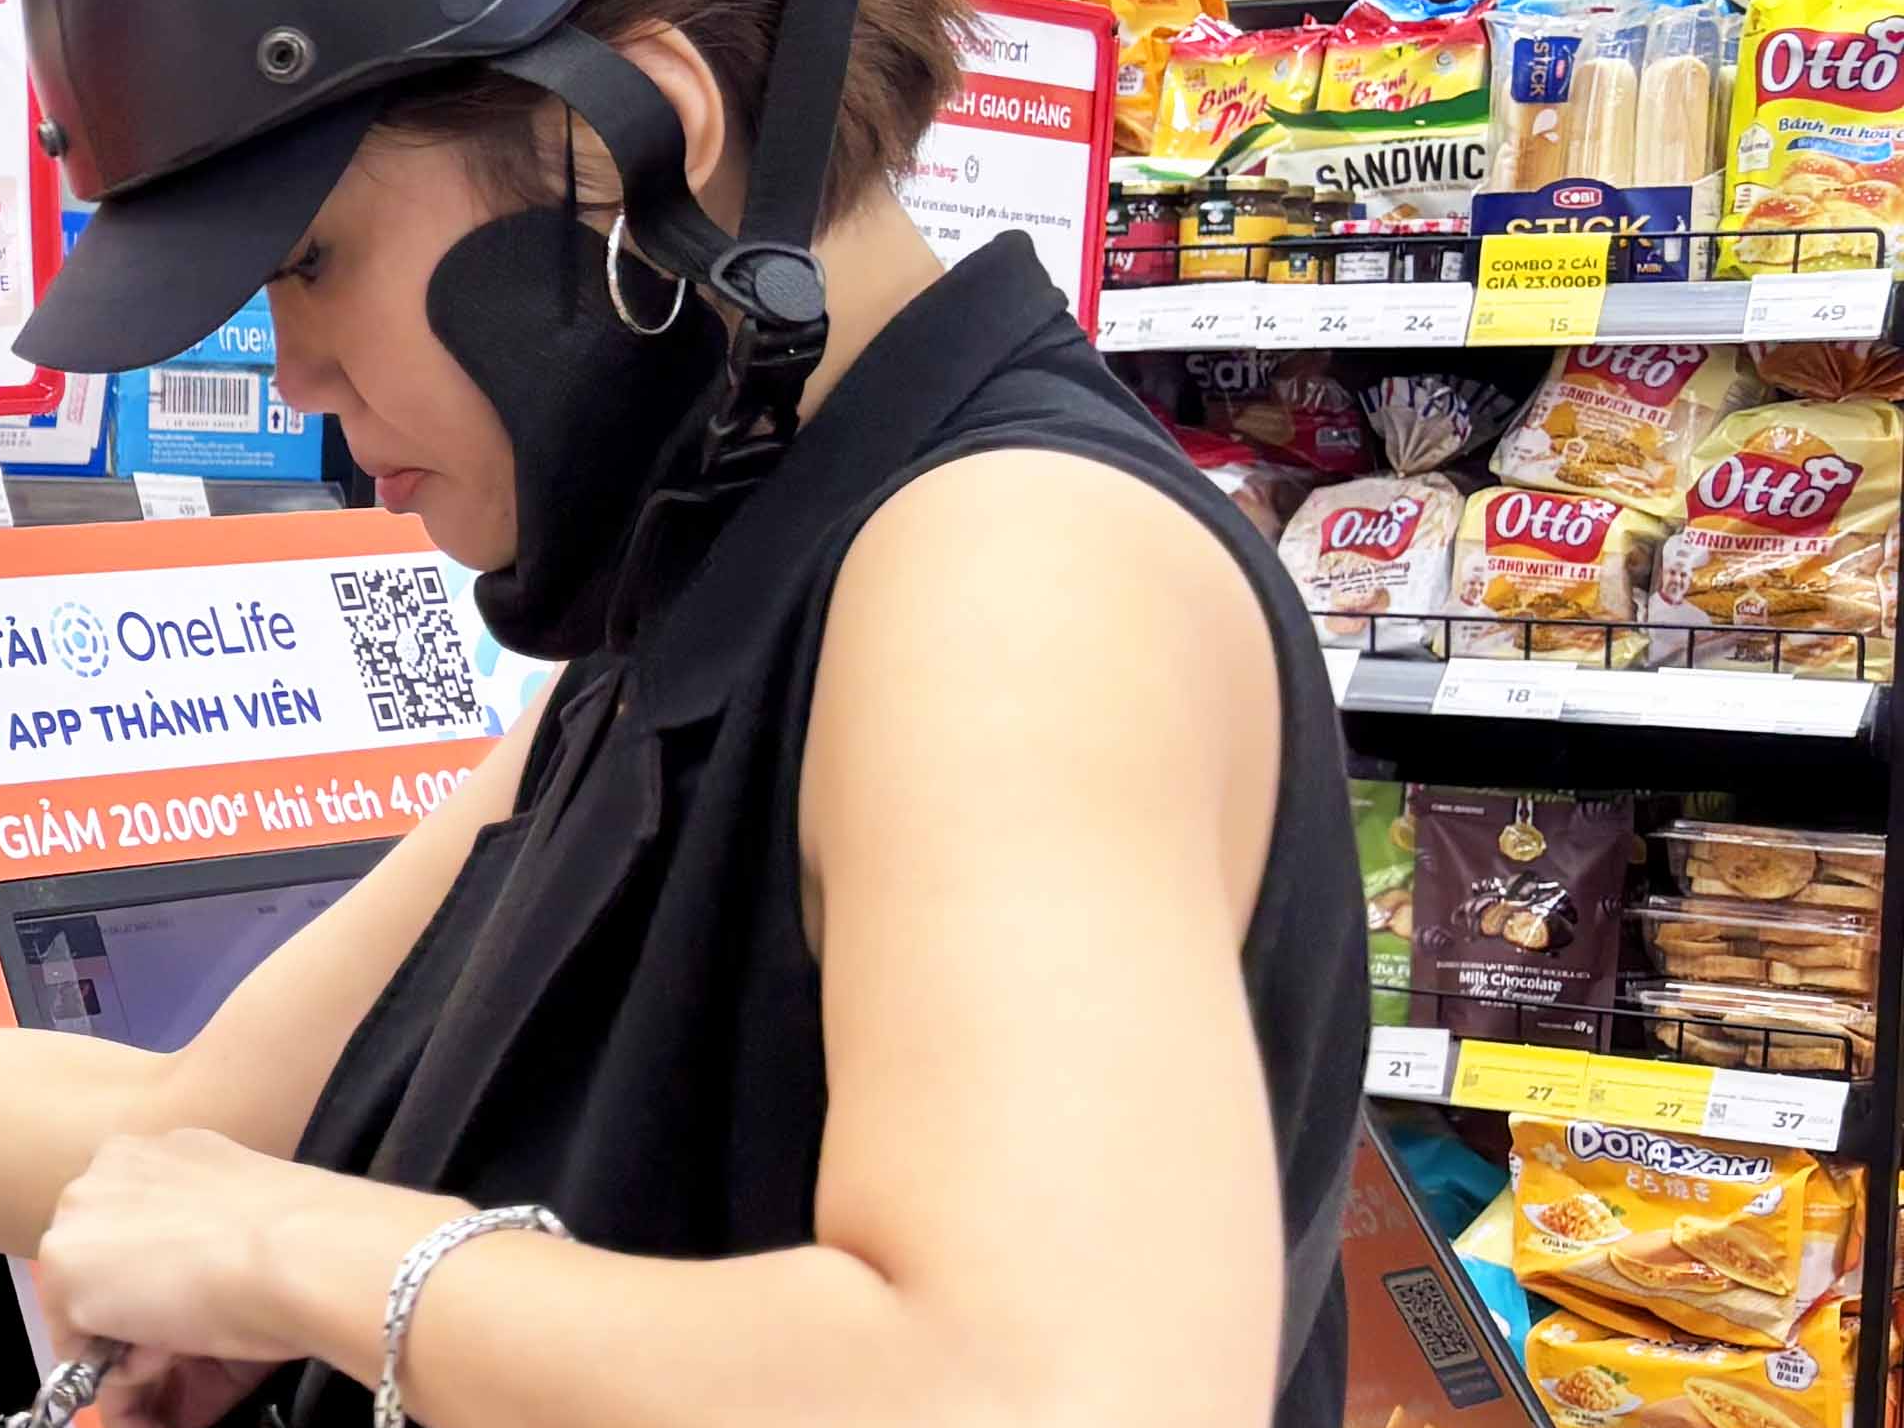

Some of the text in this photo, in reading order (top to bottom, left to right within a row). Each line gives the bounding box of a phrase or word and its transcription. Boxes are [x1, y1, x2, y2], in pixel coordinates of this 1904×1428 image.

[1762, 31, 1897, 93] Otto
[1558, 190, 1596, 206] COBI
[1492, 257, 1599, 272] COMBO 2 CÁI
[1486, 275, 1518, 290] GIÁ
[1698, 458, 1825, 519] Otto
[1495, 492, 1593, 544] Otto
[1685, 530, 1785, 553] SANDWICH
[116, 600, 297, 663] OneLife
[8, 680, 322, 751] APP THÀNH VIÊN
[1459, 971, 1562, 992] Milk Chocolate
[1389, 1060, 1412, 1078] 21
[1772, 1112, 1804, 1130] 37
